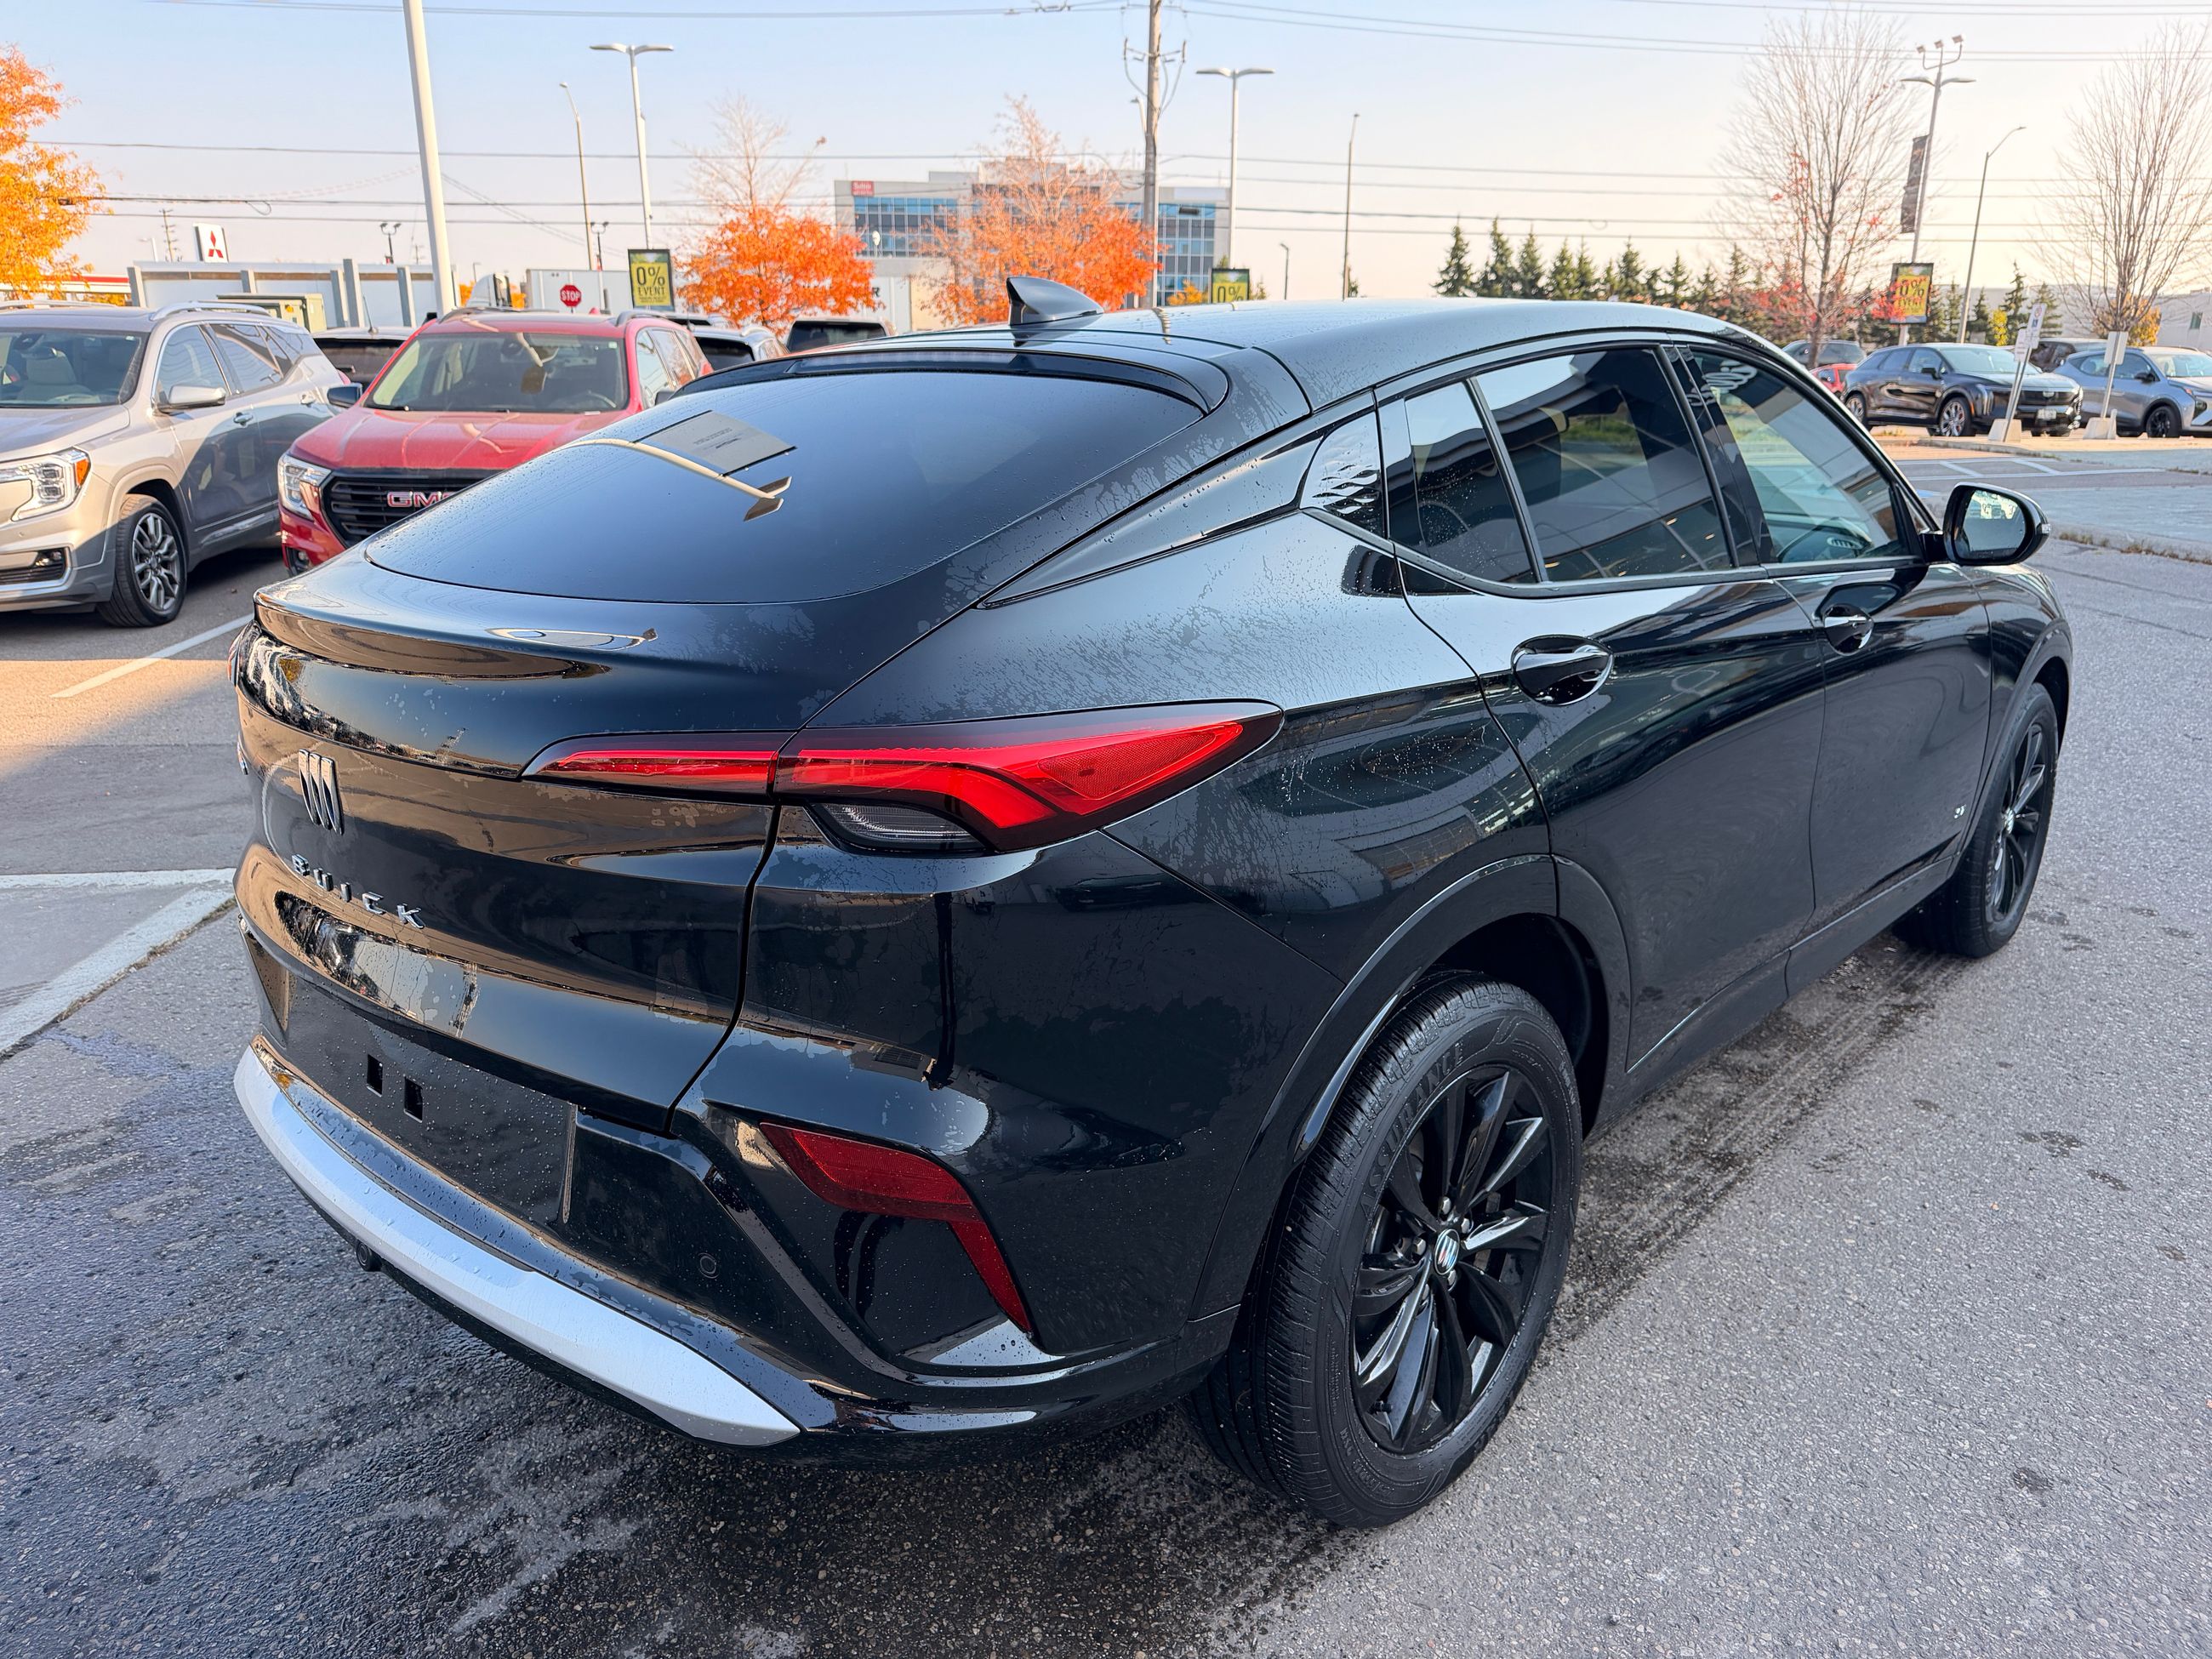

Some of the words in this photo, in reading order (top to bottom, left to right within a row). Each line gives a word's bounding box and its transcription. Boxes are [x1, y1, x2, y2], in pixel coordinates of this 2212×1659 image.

[636, 265, 665, 286] 0%
[562, 290, 581, 301] STOP
[638, 286, 665, 296] EVENT
[292, 853, 426, 929] BUICK
